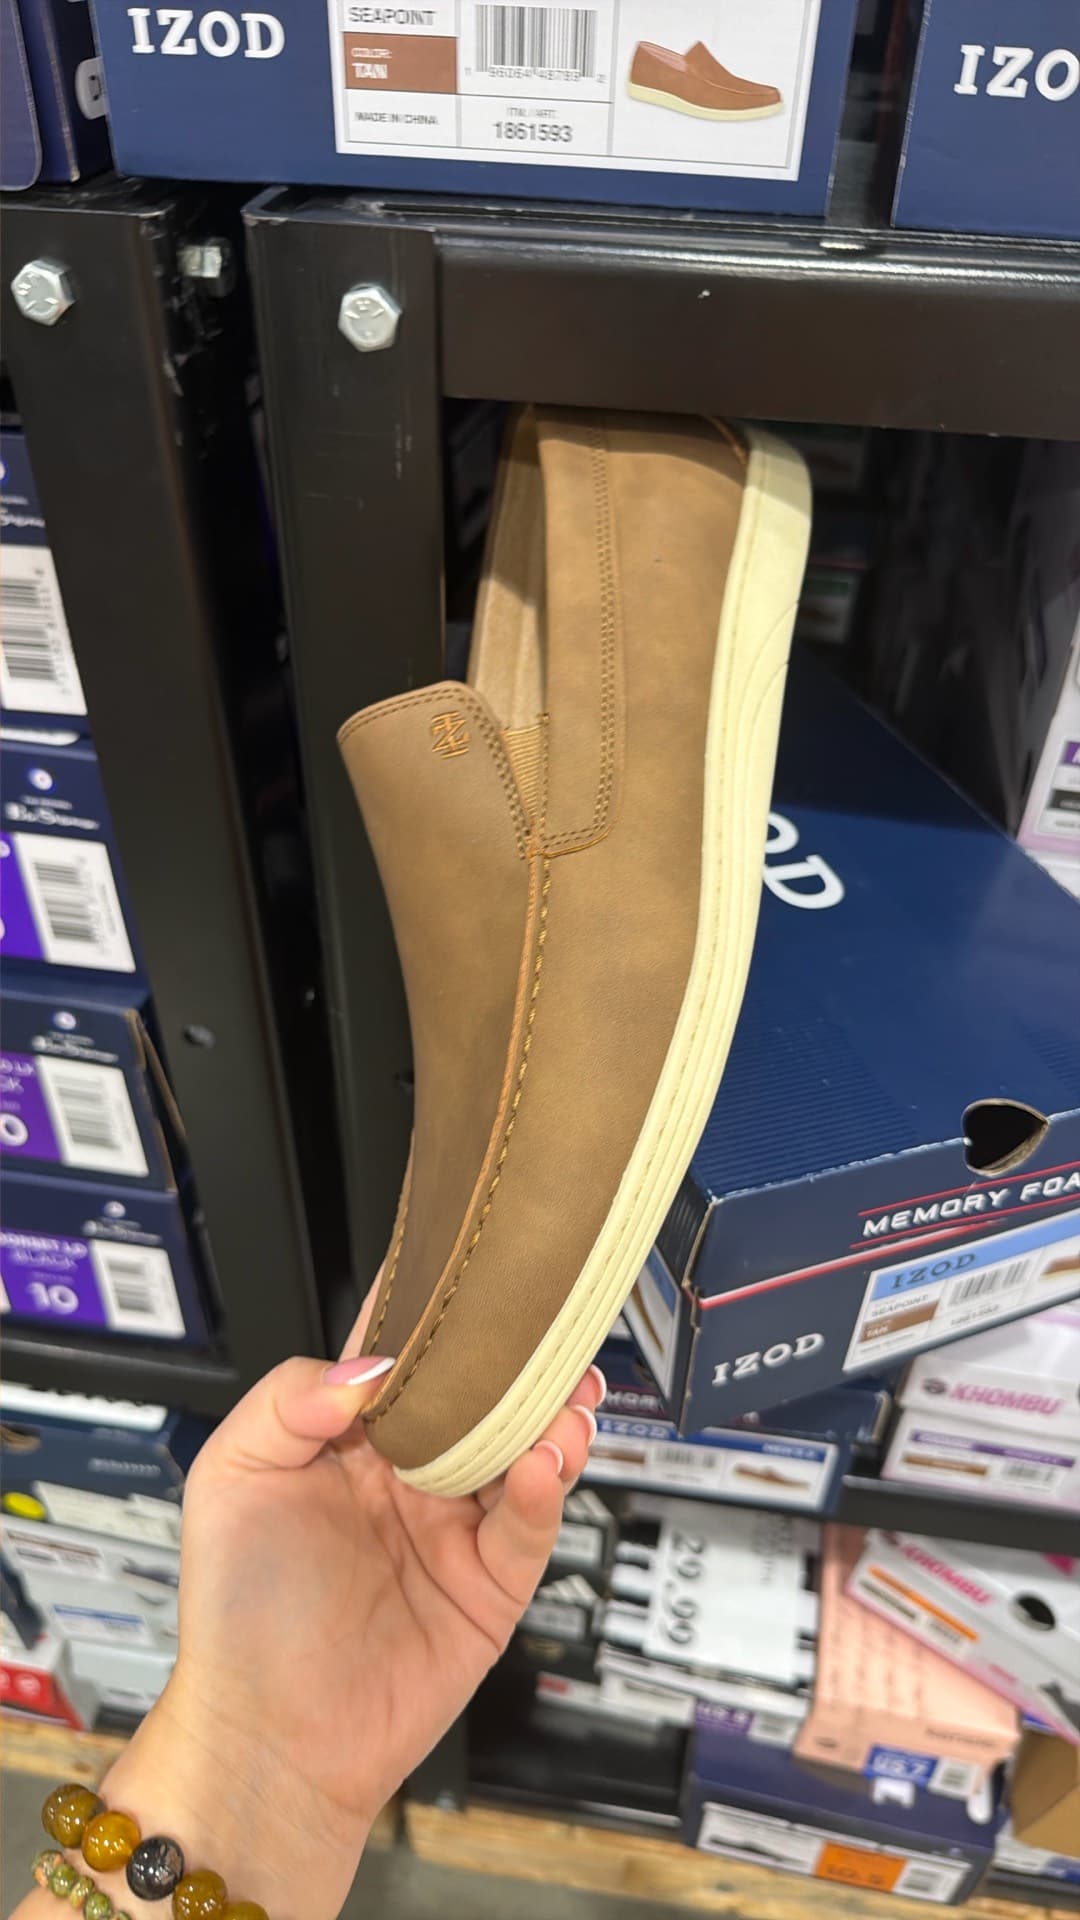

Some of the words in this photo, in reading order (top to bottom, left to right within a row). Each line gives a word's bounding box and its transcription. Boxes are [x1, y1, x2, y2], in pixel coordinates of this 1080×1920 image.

[127, 7, 286, 59] IZOD
[348, 7, 436, 25] SEAPOINT
[351, 62, 388, 79] TAN
[355, 111, 387, 122] MADE
[391, 112, 399, 123] IN
[493, 120, 573, 143] 1861593
[862, 1187, 1010, 1238] MEMORY
[891, 1253, 976, 1289] IZOD
[26, 1281, 80, 1315] 10
[711, 1332, 825, 1387] IZOD
[951, 1382, 1063, 1415] KHOMBU
[600, 1419, 669, 1441] IZOD
[660, 1530, 706, 1647] 29.99
[901, 1543, 992, 1606] KHOMBU
